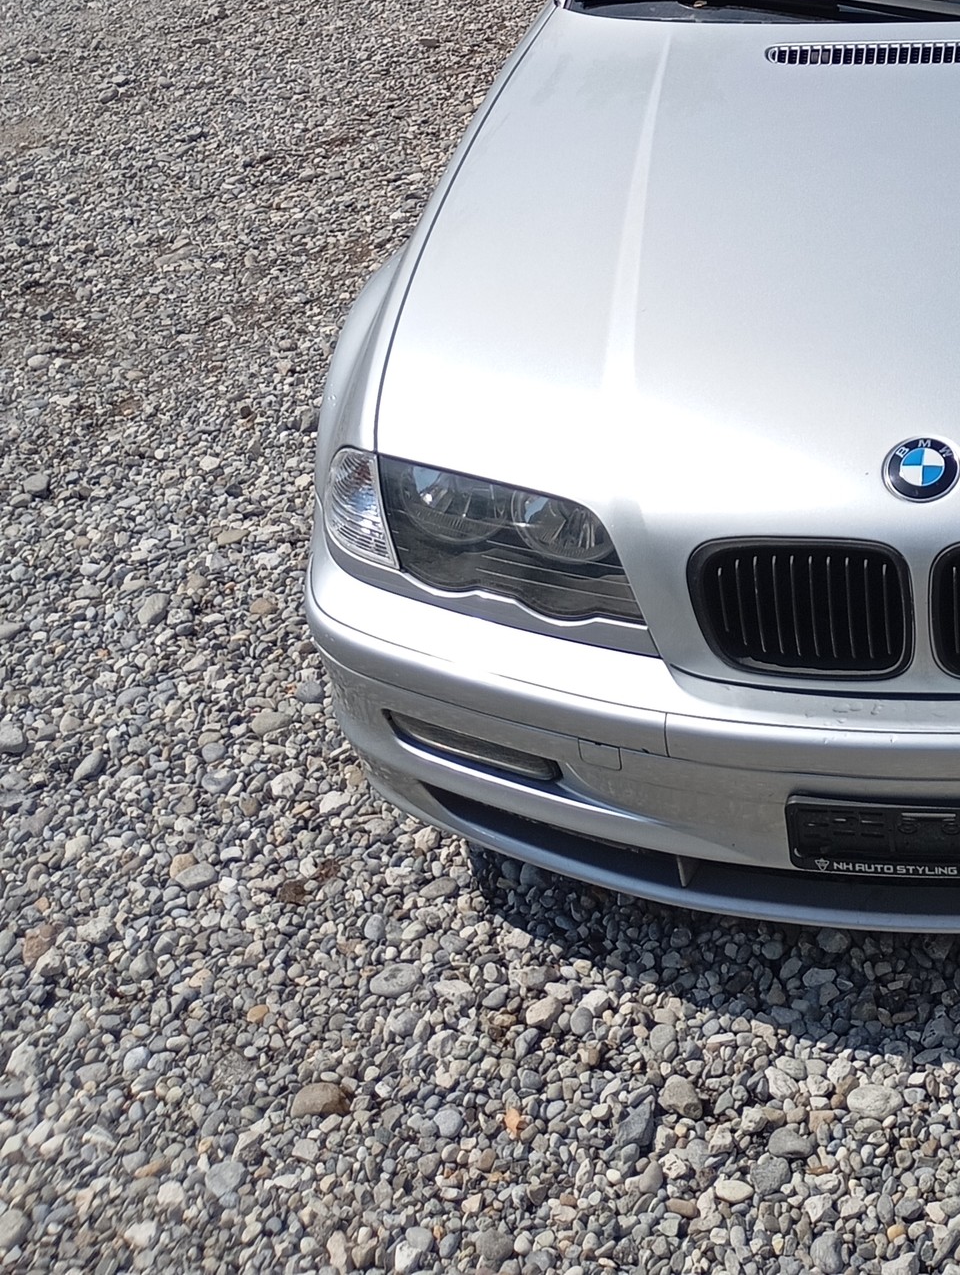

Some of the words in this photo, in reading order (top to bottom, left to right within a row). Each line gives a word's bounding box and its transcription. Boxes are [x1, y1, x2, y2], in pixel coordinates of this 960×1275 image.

[896, 439, 953, 458] BMW
[833, 861, 853, 871] NH
[855, 863, 893, 873] AUTO
[897, 865, 957, 875] STYLING
